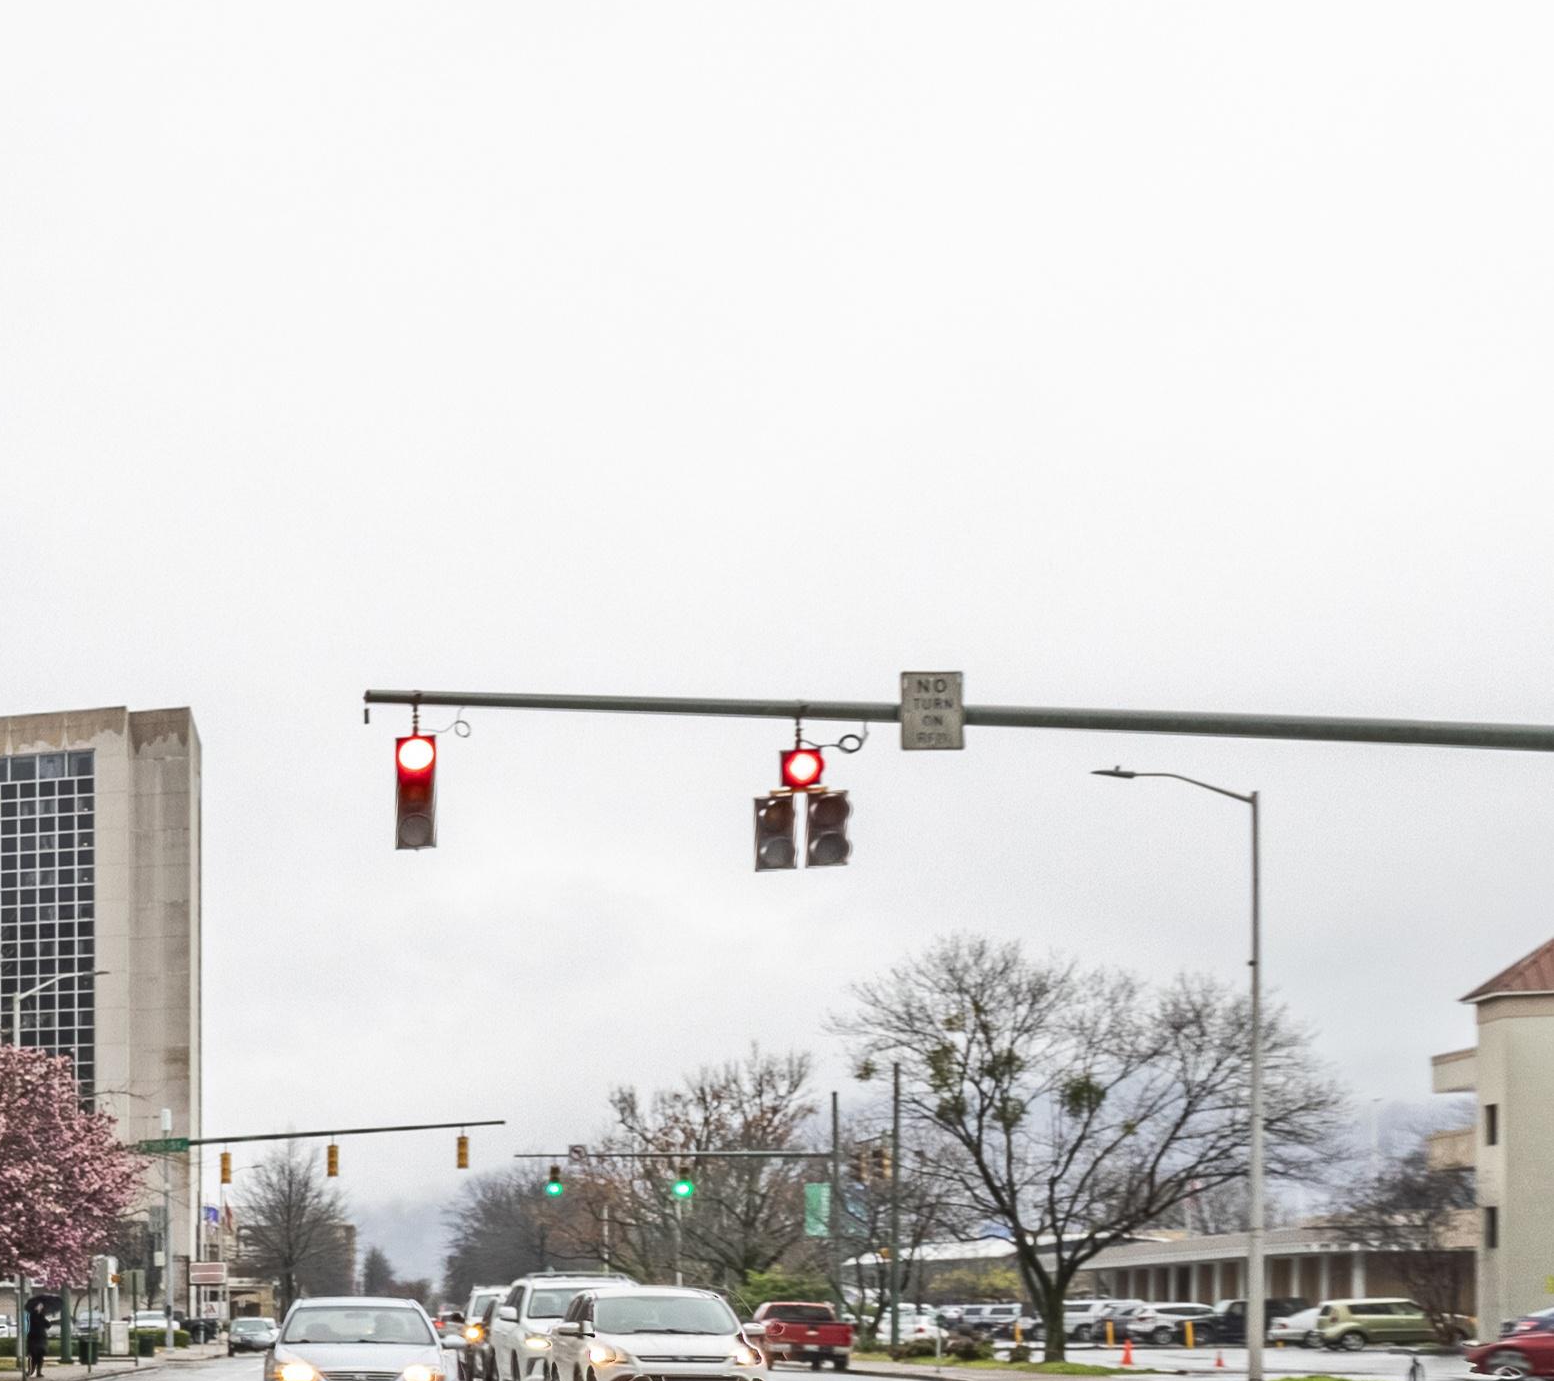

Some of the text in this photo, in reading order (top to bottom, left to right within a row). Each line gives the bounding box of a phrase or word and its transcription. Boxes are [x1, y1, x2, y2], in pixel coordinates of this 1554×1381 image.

[917, 679, 947, 693] NO
[913, 697, 953, 710] TURN
[921, 714, 943, 727] ON
